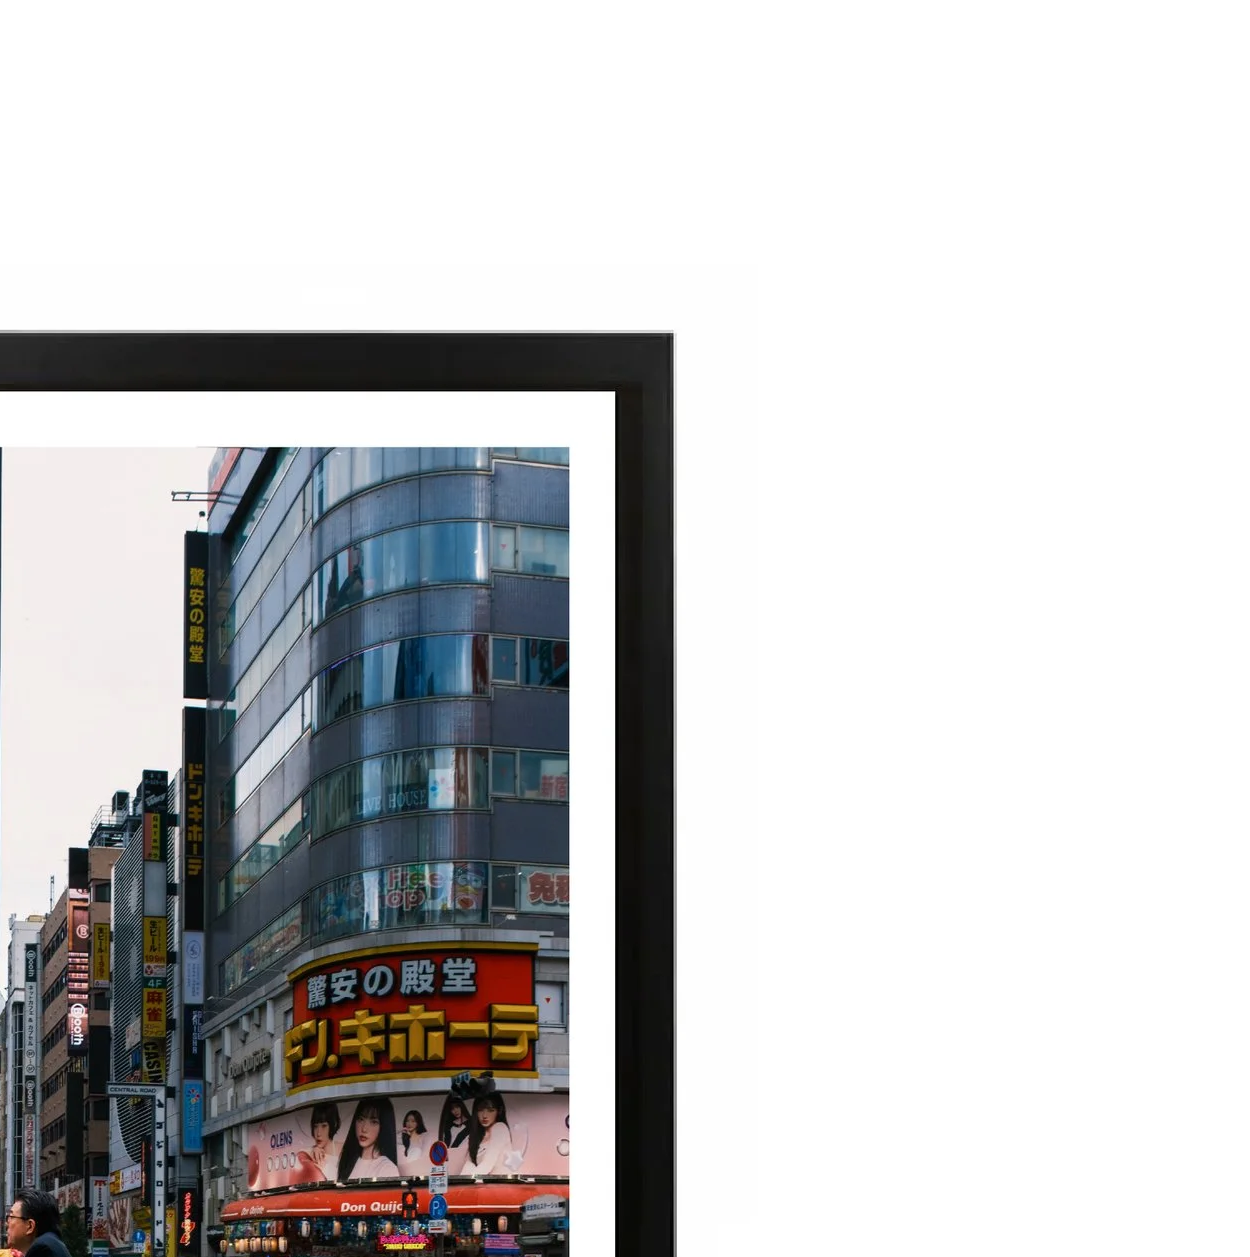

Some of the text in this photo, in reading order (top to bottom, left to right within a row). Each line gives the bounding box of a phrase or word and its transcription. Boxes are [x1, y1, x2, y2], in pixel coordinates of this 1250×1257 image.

[189, 567, 204, 663] 驚安の殿堂
[389, 790, 427, 808] HOUSE
[147, 979, 162, 987] 4F
[307, 957, 477, 1009] 驚安の殿堂
[146, 991, 163, 1022] 麻雀
[70, 1003, 85, 1046] Booth
[270, 1131, 293, 1148] OLENS
[341, 1202, 366, 1212] Don
